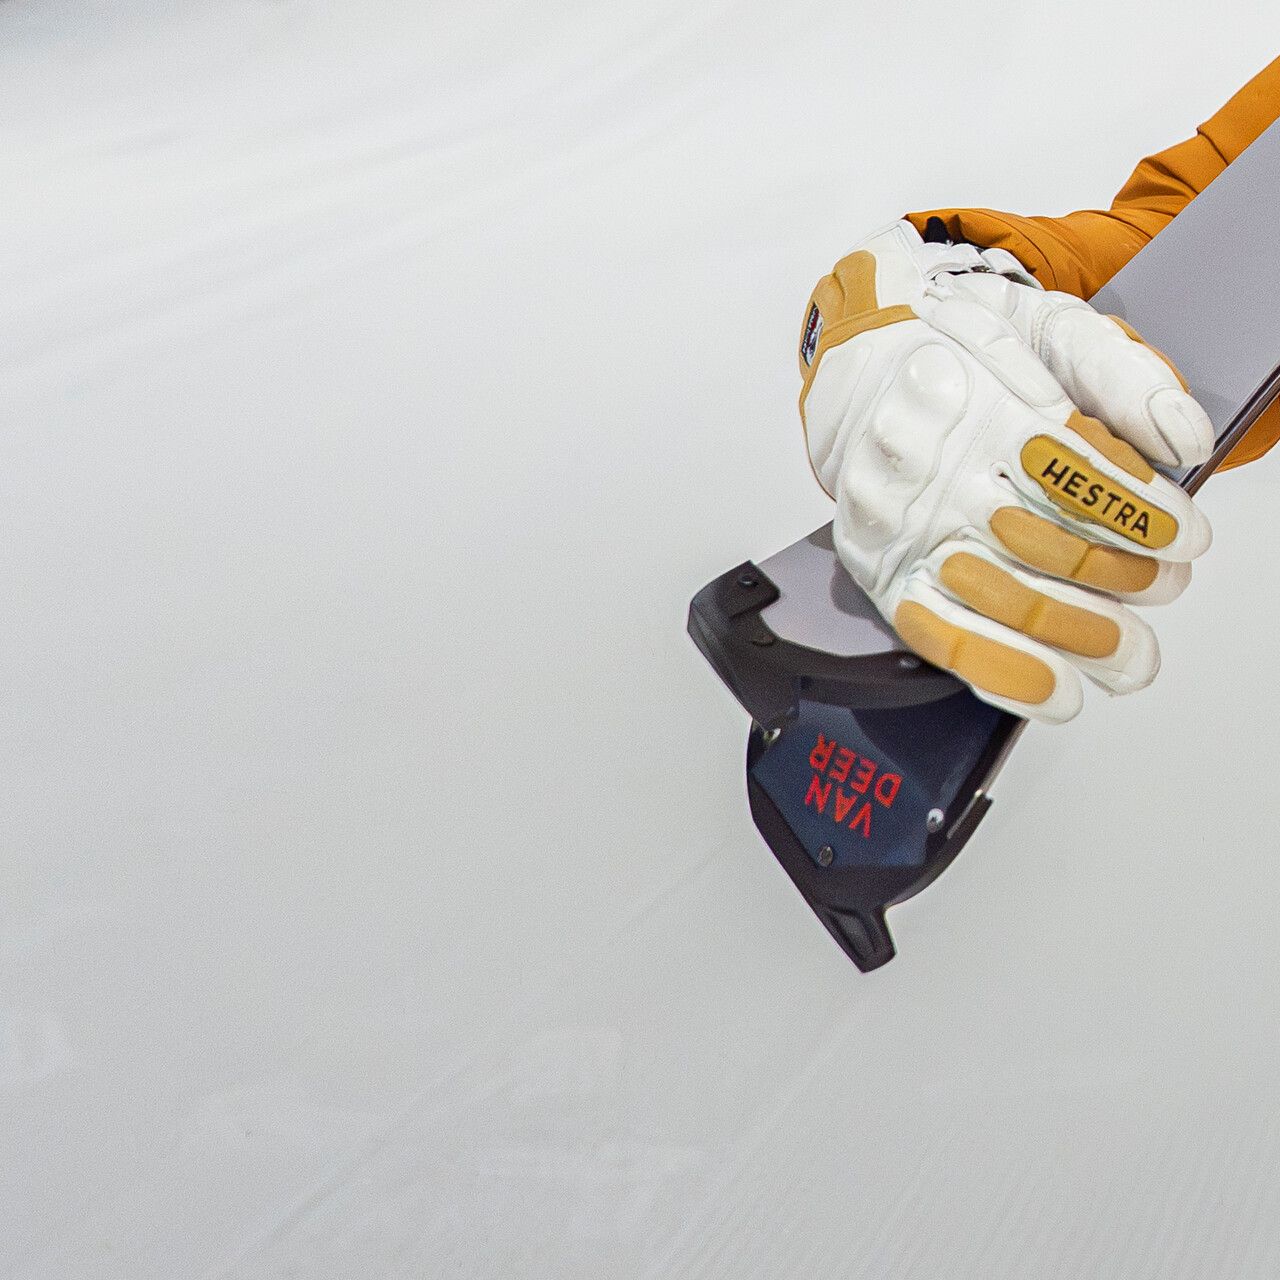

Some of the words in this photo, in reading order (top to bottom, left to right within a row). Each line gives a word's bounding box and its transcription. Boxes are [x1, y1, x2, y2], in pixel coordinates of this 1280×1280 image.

[1041, 457, 1151, 539] HESTRA
[804, 773, 873, 840] VAN
[809, 731, 903, 809] DEER
